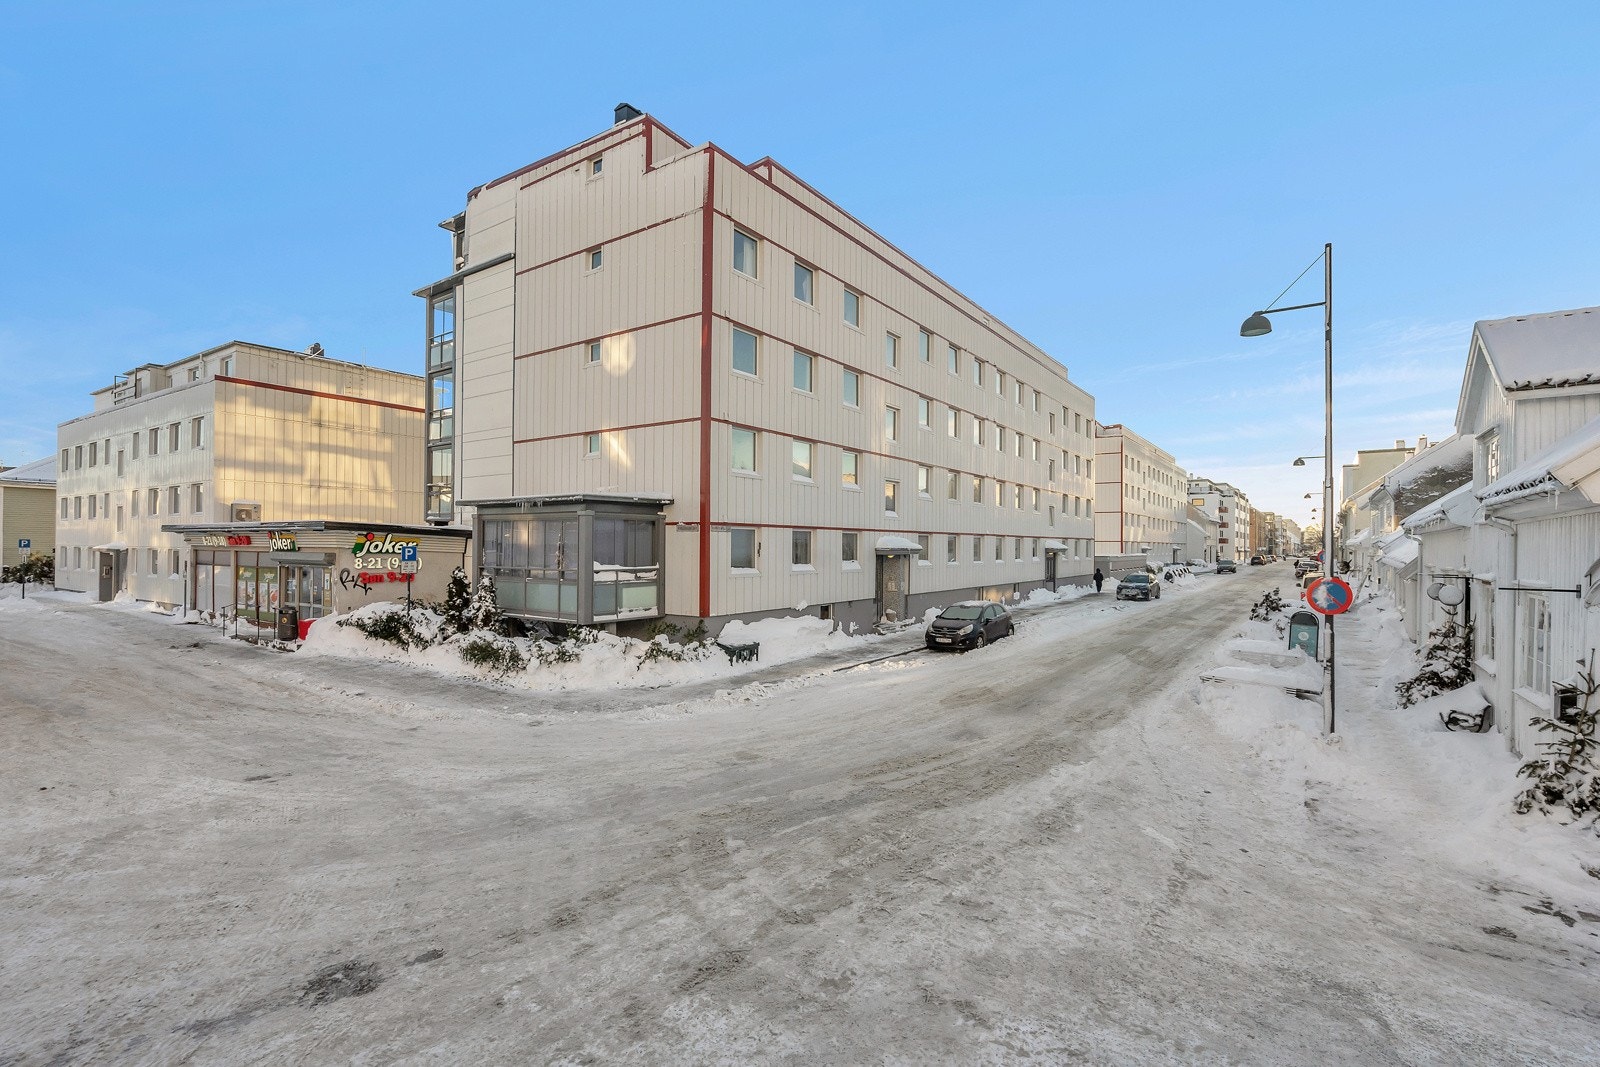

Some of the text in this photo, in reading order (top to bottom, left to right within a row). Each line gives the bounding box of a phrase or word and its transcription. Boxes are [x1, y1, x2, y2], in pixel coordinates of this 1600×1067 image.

[267, 531, 291, 552] joker
[405, 548, 414, 560] P
[354, 557, 383, 569] 8-21
[387, 557, 423, 570] (9-)
